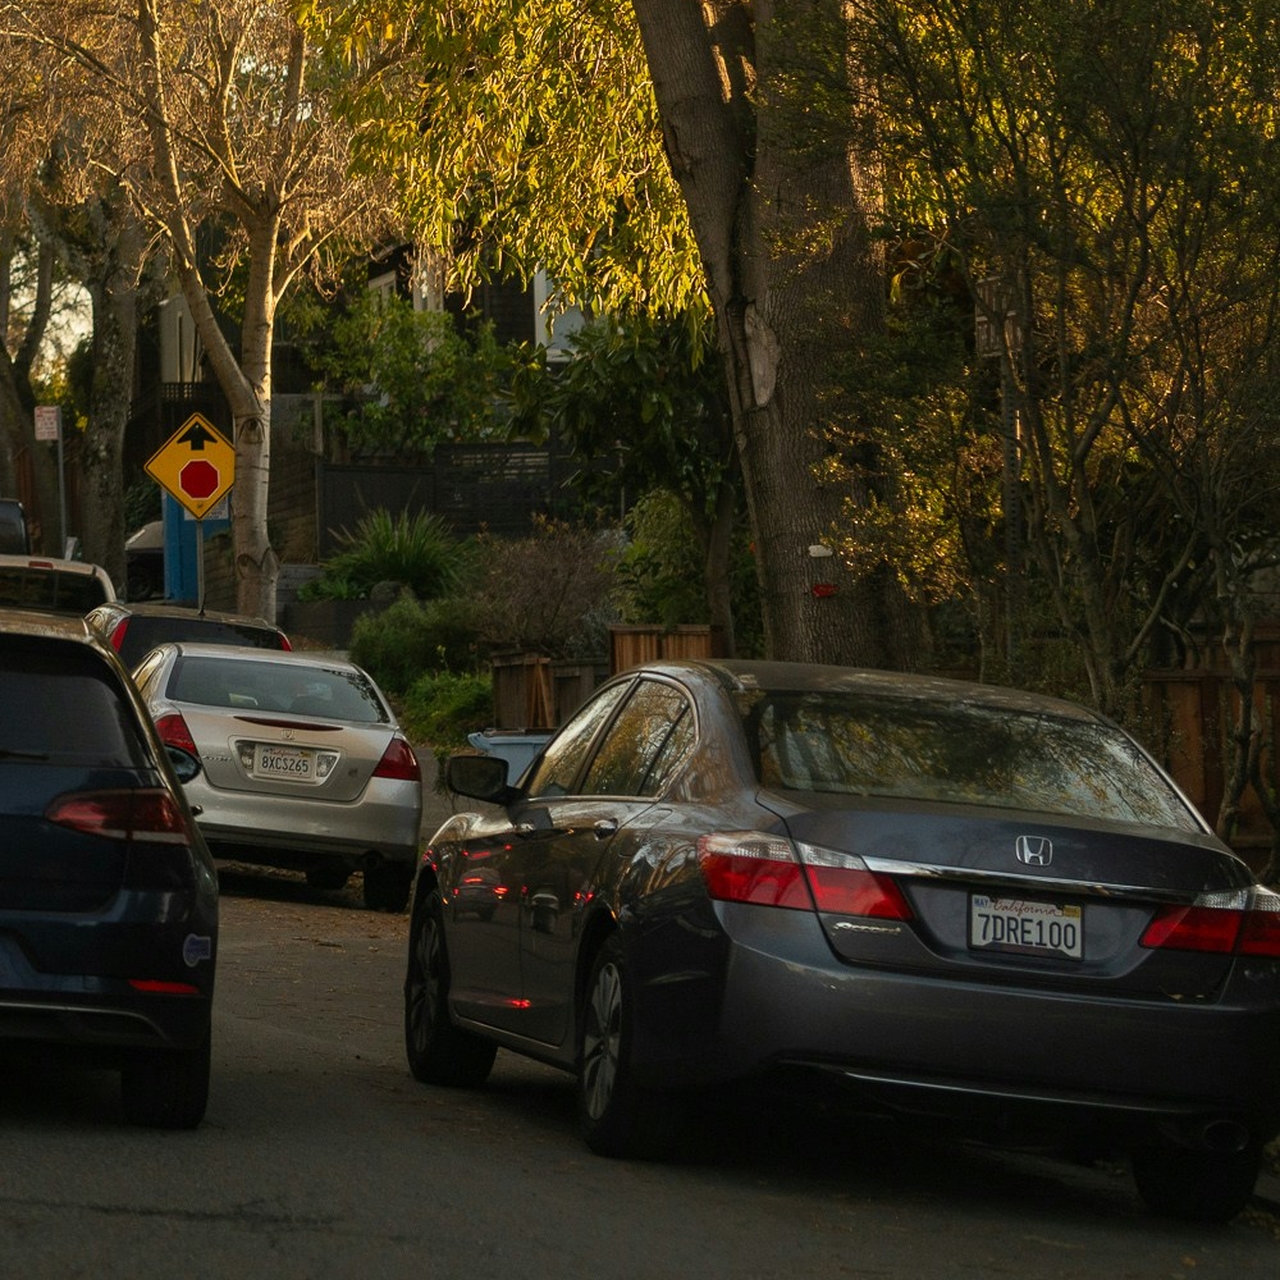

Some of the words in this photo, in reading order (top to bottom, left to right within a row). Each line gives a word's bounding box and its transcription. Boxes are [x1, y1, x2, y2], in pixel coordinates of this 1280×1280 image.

[261, 755, 309, 773] 8XCS265
[993, 899, 1057, 917] California
[977, 913, 1077, 950] 7DRE100
